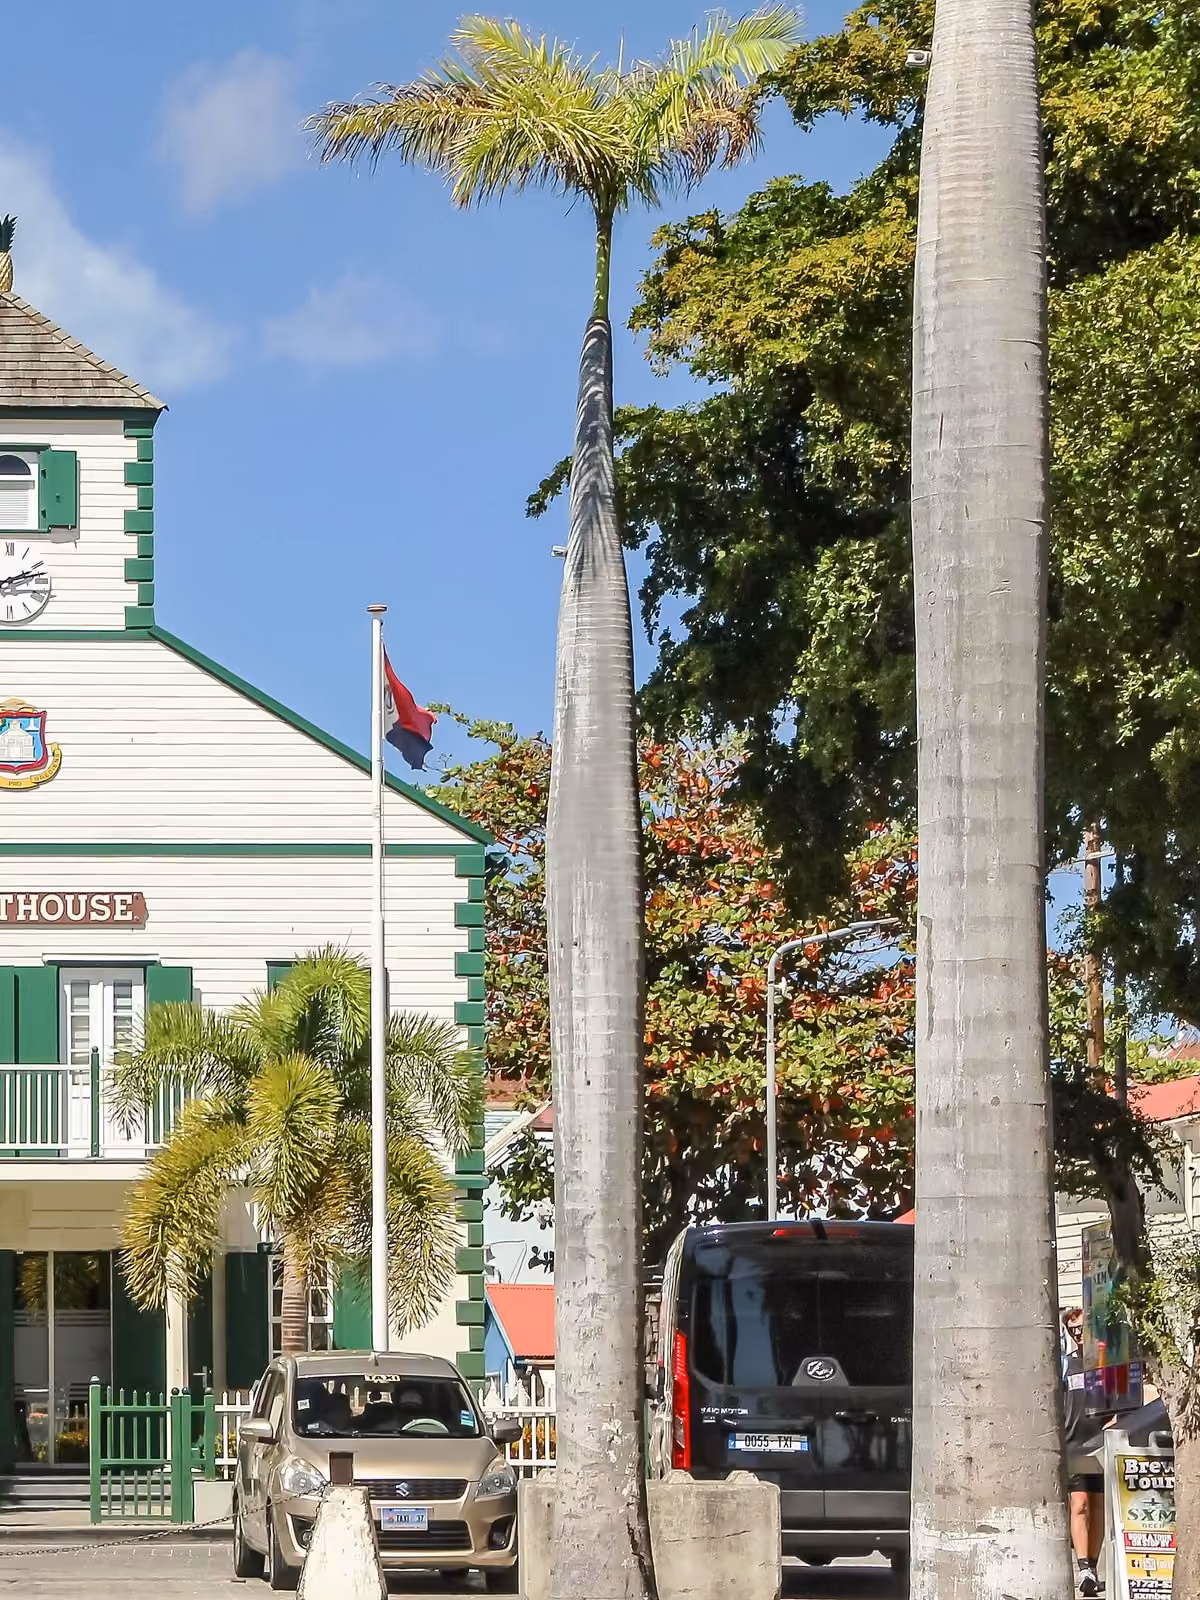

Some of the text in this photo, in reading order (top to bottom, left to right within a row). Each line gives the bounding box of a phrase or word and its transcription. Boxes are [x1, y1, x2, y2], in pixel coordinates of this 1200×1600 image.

[368, 1374, 400, 1382] TAXI
[1125, 1458, 1175, 1474] Brew
[1124, 1474, 1176, 1489] Tour
[396, 1514, 410, 1523] TAXI
[1127, 1508, 1177, 1526] SXM
